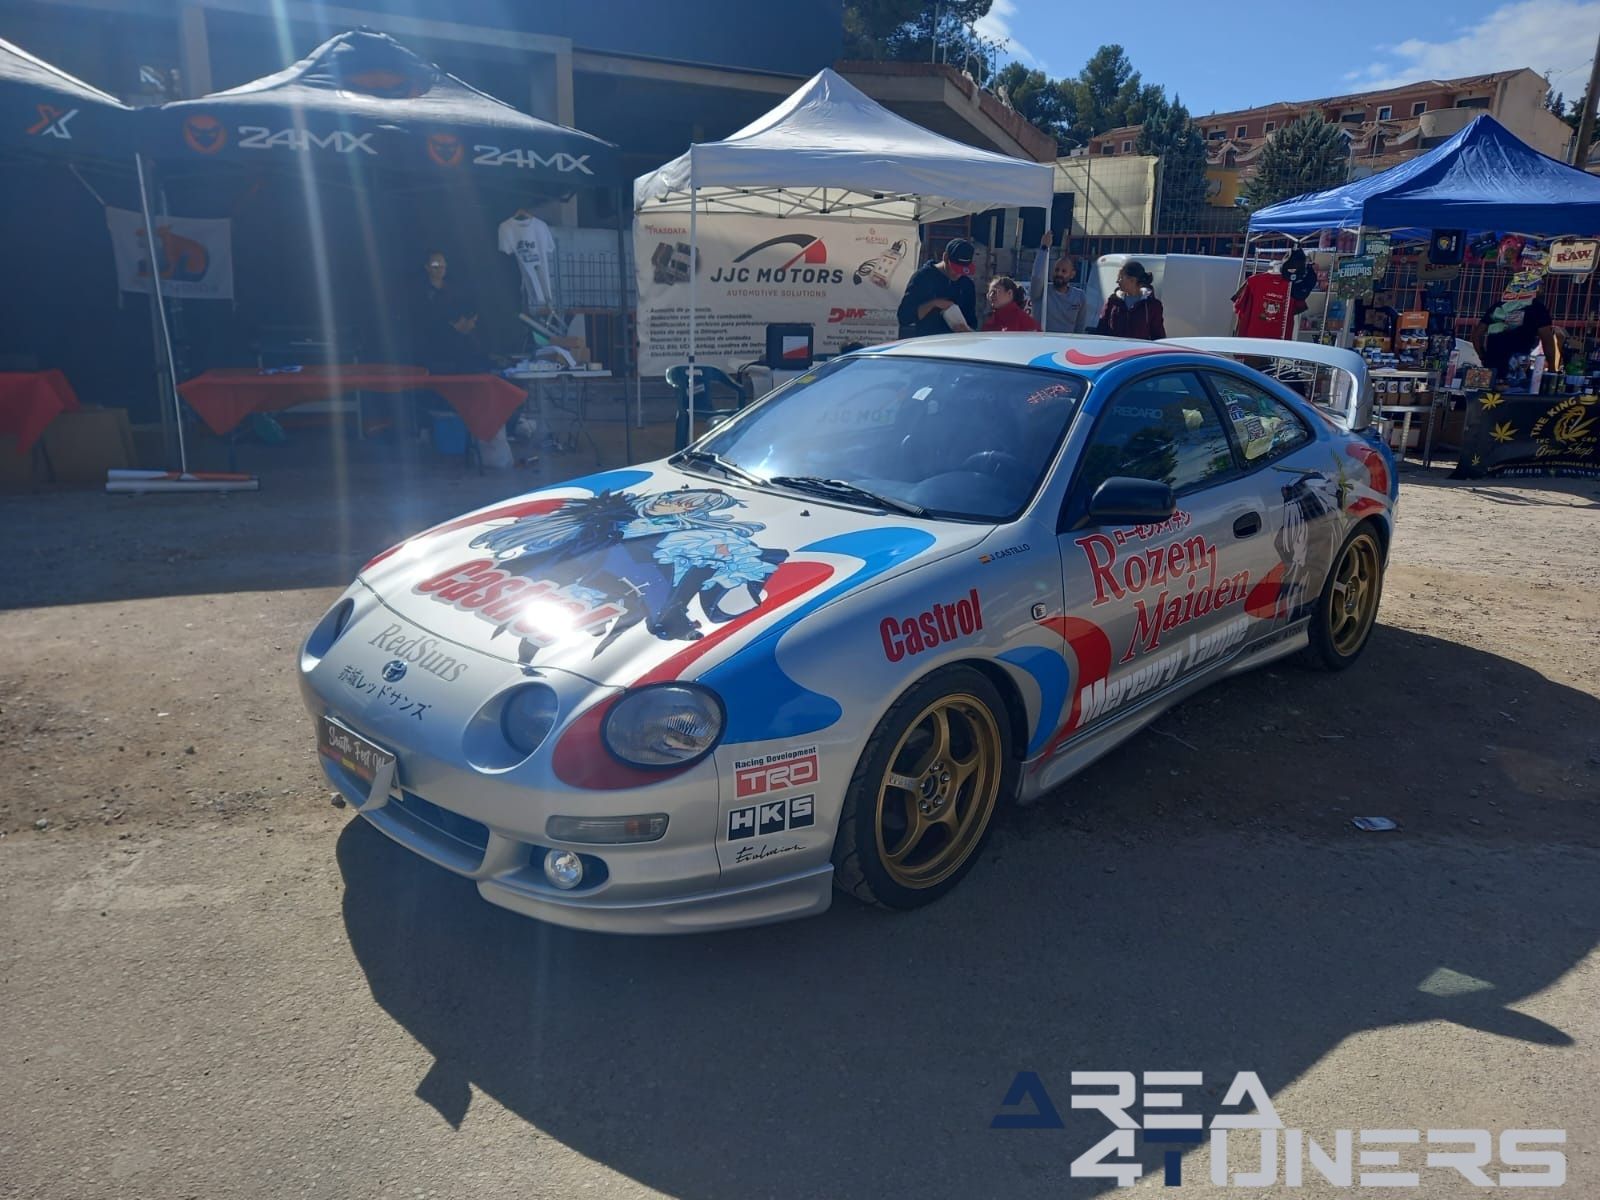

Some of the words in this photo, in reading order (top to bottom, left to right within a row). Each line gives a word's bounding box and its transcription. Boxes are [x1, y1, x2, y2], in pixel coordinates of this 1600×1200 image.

[238, 126, 377, 154] 24MX
[473, 145, 594, 174] 24MX
[1556, 249, 1593, 263] RAW
[710, 267, 750, 283] JJC
[756, 267, 844, 284] MOTORS
[727, 289, 778, 298] AUTOMOTIVE
[781, 290, 827, 298] SOLUTIONS
[1547, 396, 1577, 418] KING
[1075, 534, 1211, 609] Rozen
[1118, 545, 1251, 665] Maiden
[879, 588, 984, 663] Castrol
[368, 622, 469, 682] RedSuns
[1076, 650, 1184, 729] Mercury
[328, 725, 353, 754] South
[735, 756, 764, 769] Racing
[766, 745, 817, 764] Development
[740, 761, 814, 793] TRD
[730, 796, 814, 831] HKS
